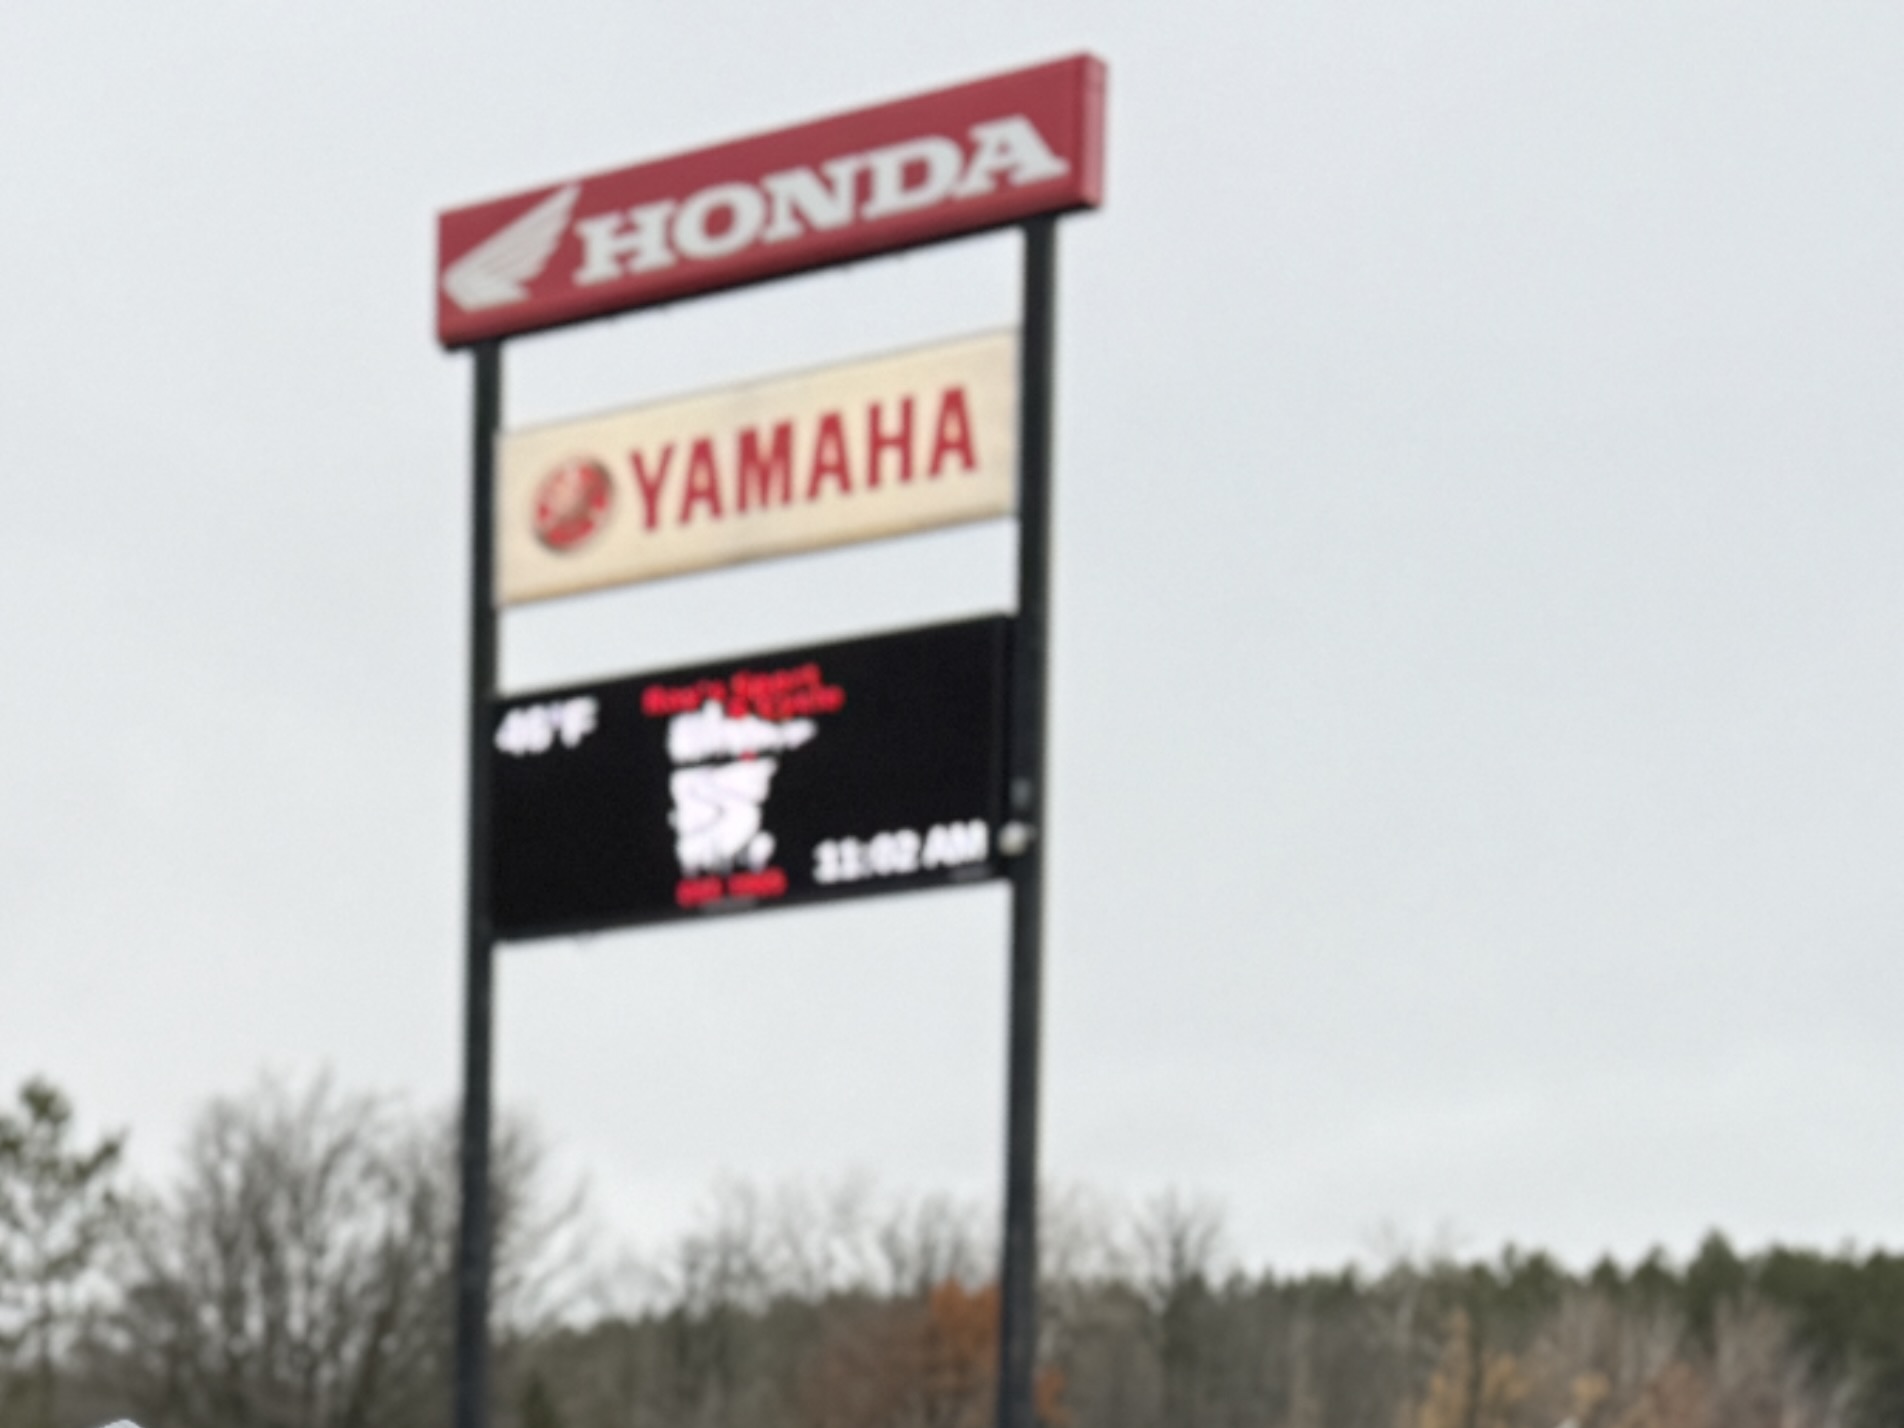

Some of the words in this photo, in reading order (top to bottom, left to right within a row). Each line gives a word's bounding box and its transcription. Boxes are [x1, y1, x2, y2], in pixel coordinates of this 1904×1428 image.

[575, 115, 1070, 287] HONDA
[630, 386, 980, 534] YAMAHA
[922, 821, 991, 868] AM
